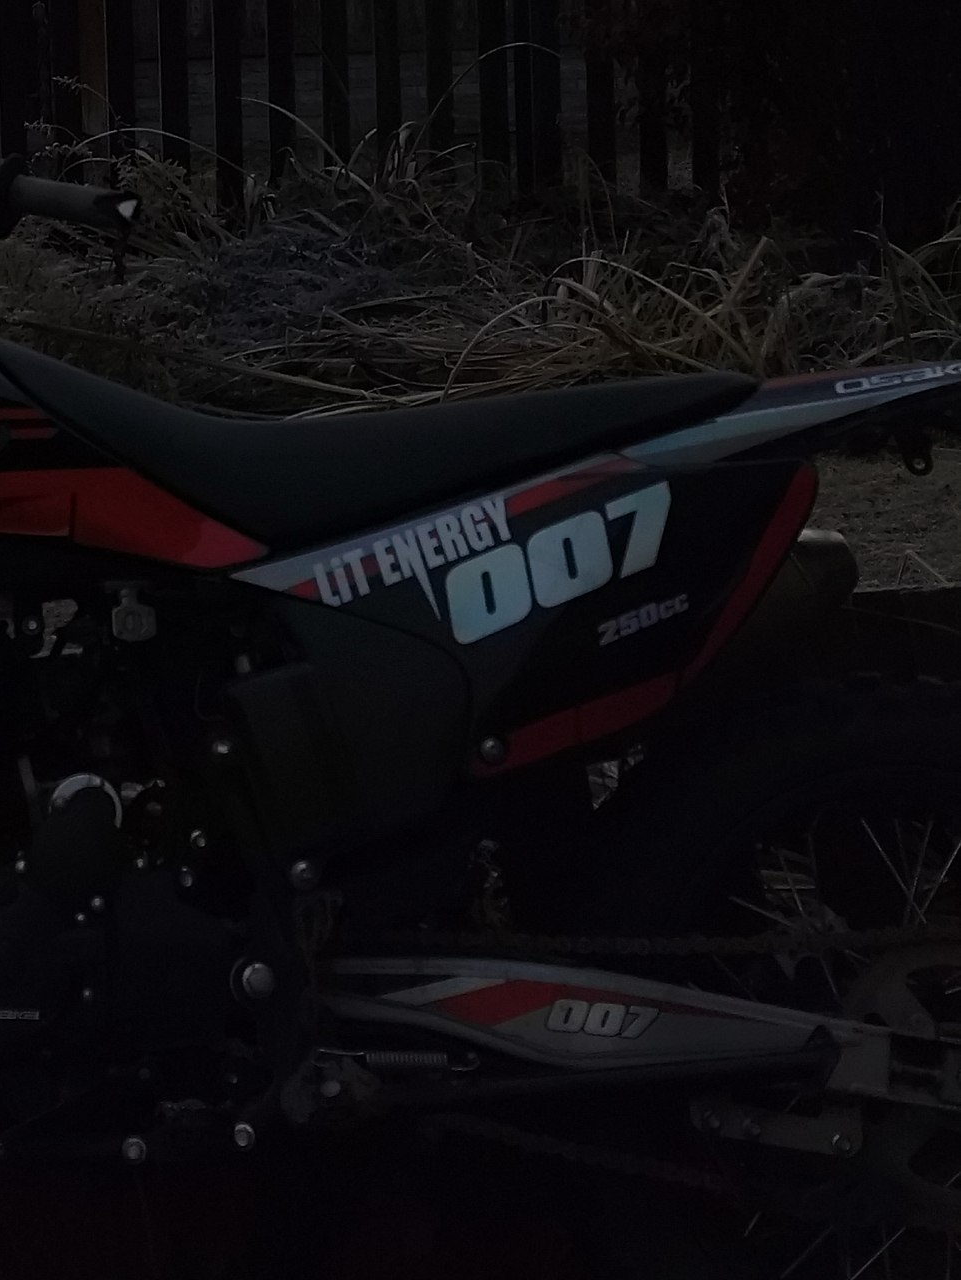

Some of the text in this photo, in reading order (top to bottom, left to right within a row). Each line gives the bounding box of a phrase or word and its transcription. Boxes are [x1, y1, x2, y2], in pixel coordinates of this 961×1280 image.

[373, 494, 513, 622] ENERGY
[445, 480, 672, 646] 007
[545, 999, 660, 1039] 007
